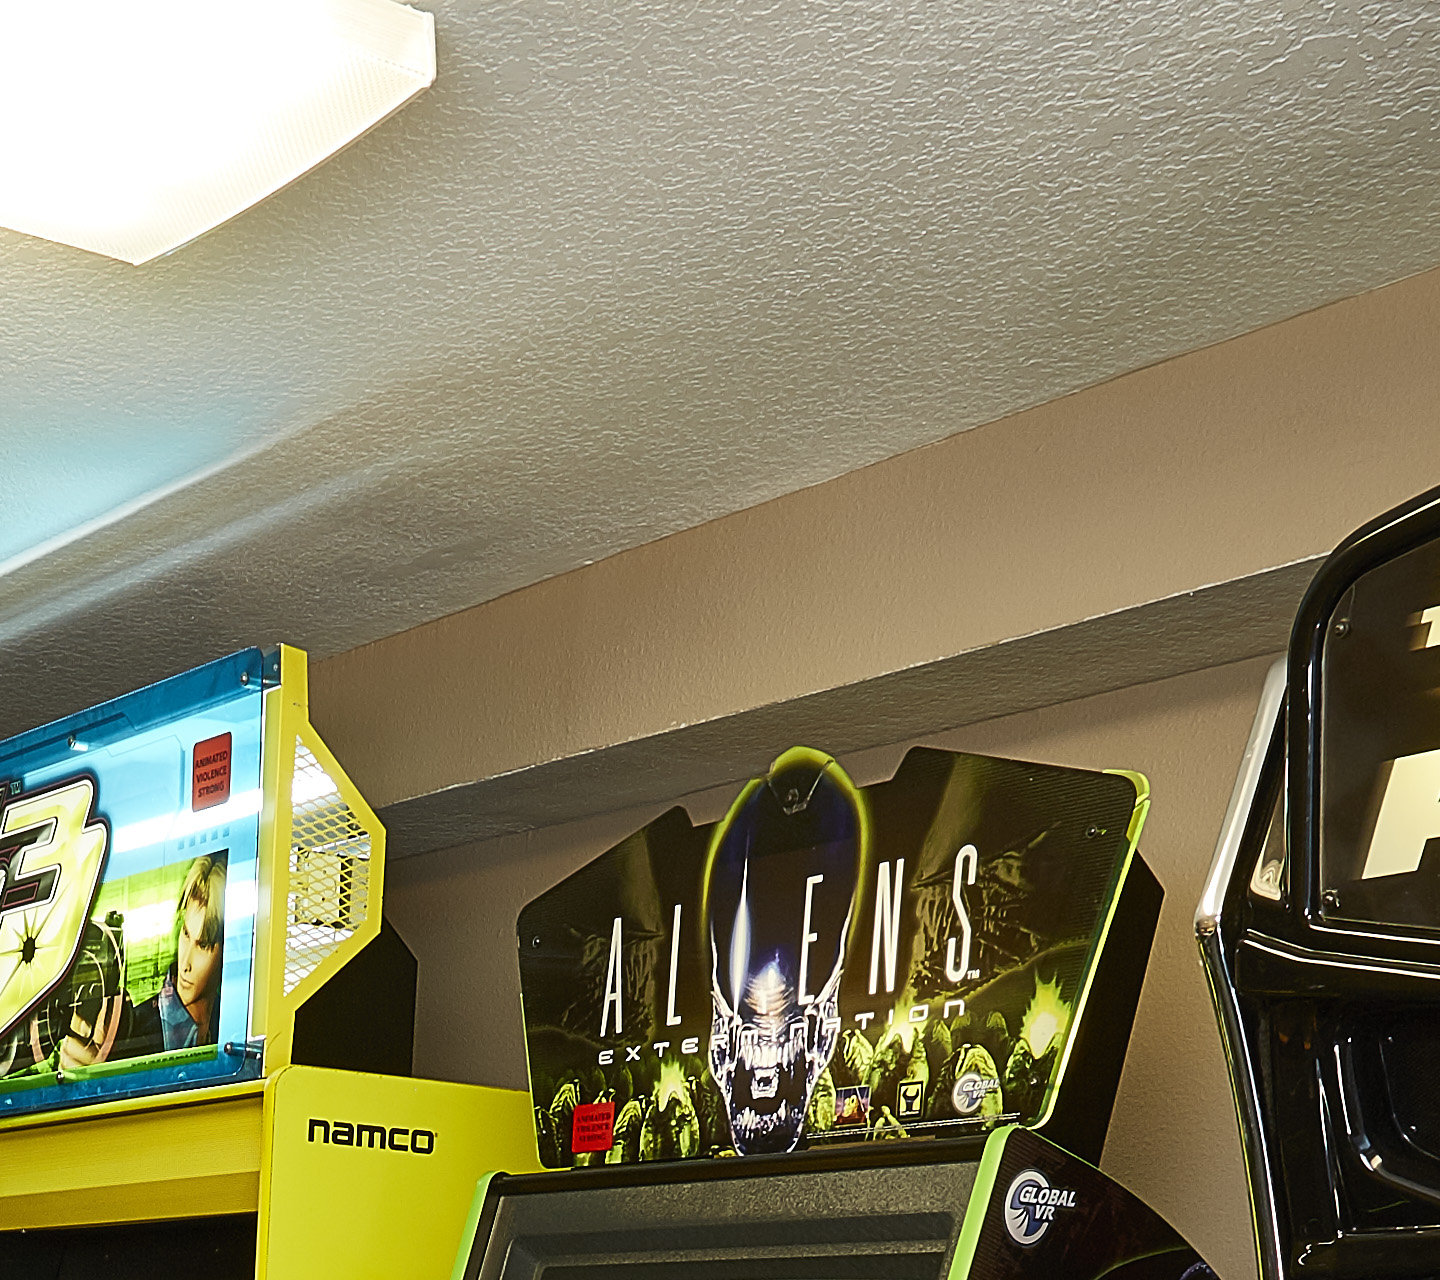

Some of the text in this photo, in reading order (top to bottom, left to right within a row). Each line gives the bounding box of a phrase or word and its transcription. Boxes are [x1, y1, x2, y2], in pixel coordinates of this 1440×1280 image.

[195, 751, 228, 768] ANIMATED
[196, 765, 227, 783] VIOLENCE
[599, 844, 978, 1037] ALIENS
[598, 999, 968, 1066] EXTERMINATION
[963, 1079, 1001, 1092] GLOBAL
[972, 1089, 987, 1098] VR
[308, 1118, 434, 1154] namco
[1020, 1186, 1076, 1207] GLOBAL
[1035, 1204, 1055, 1221] VR
